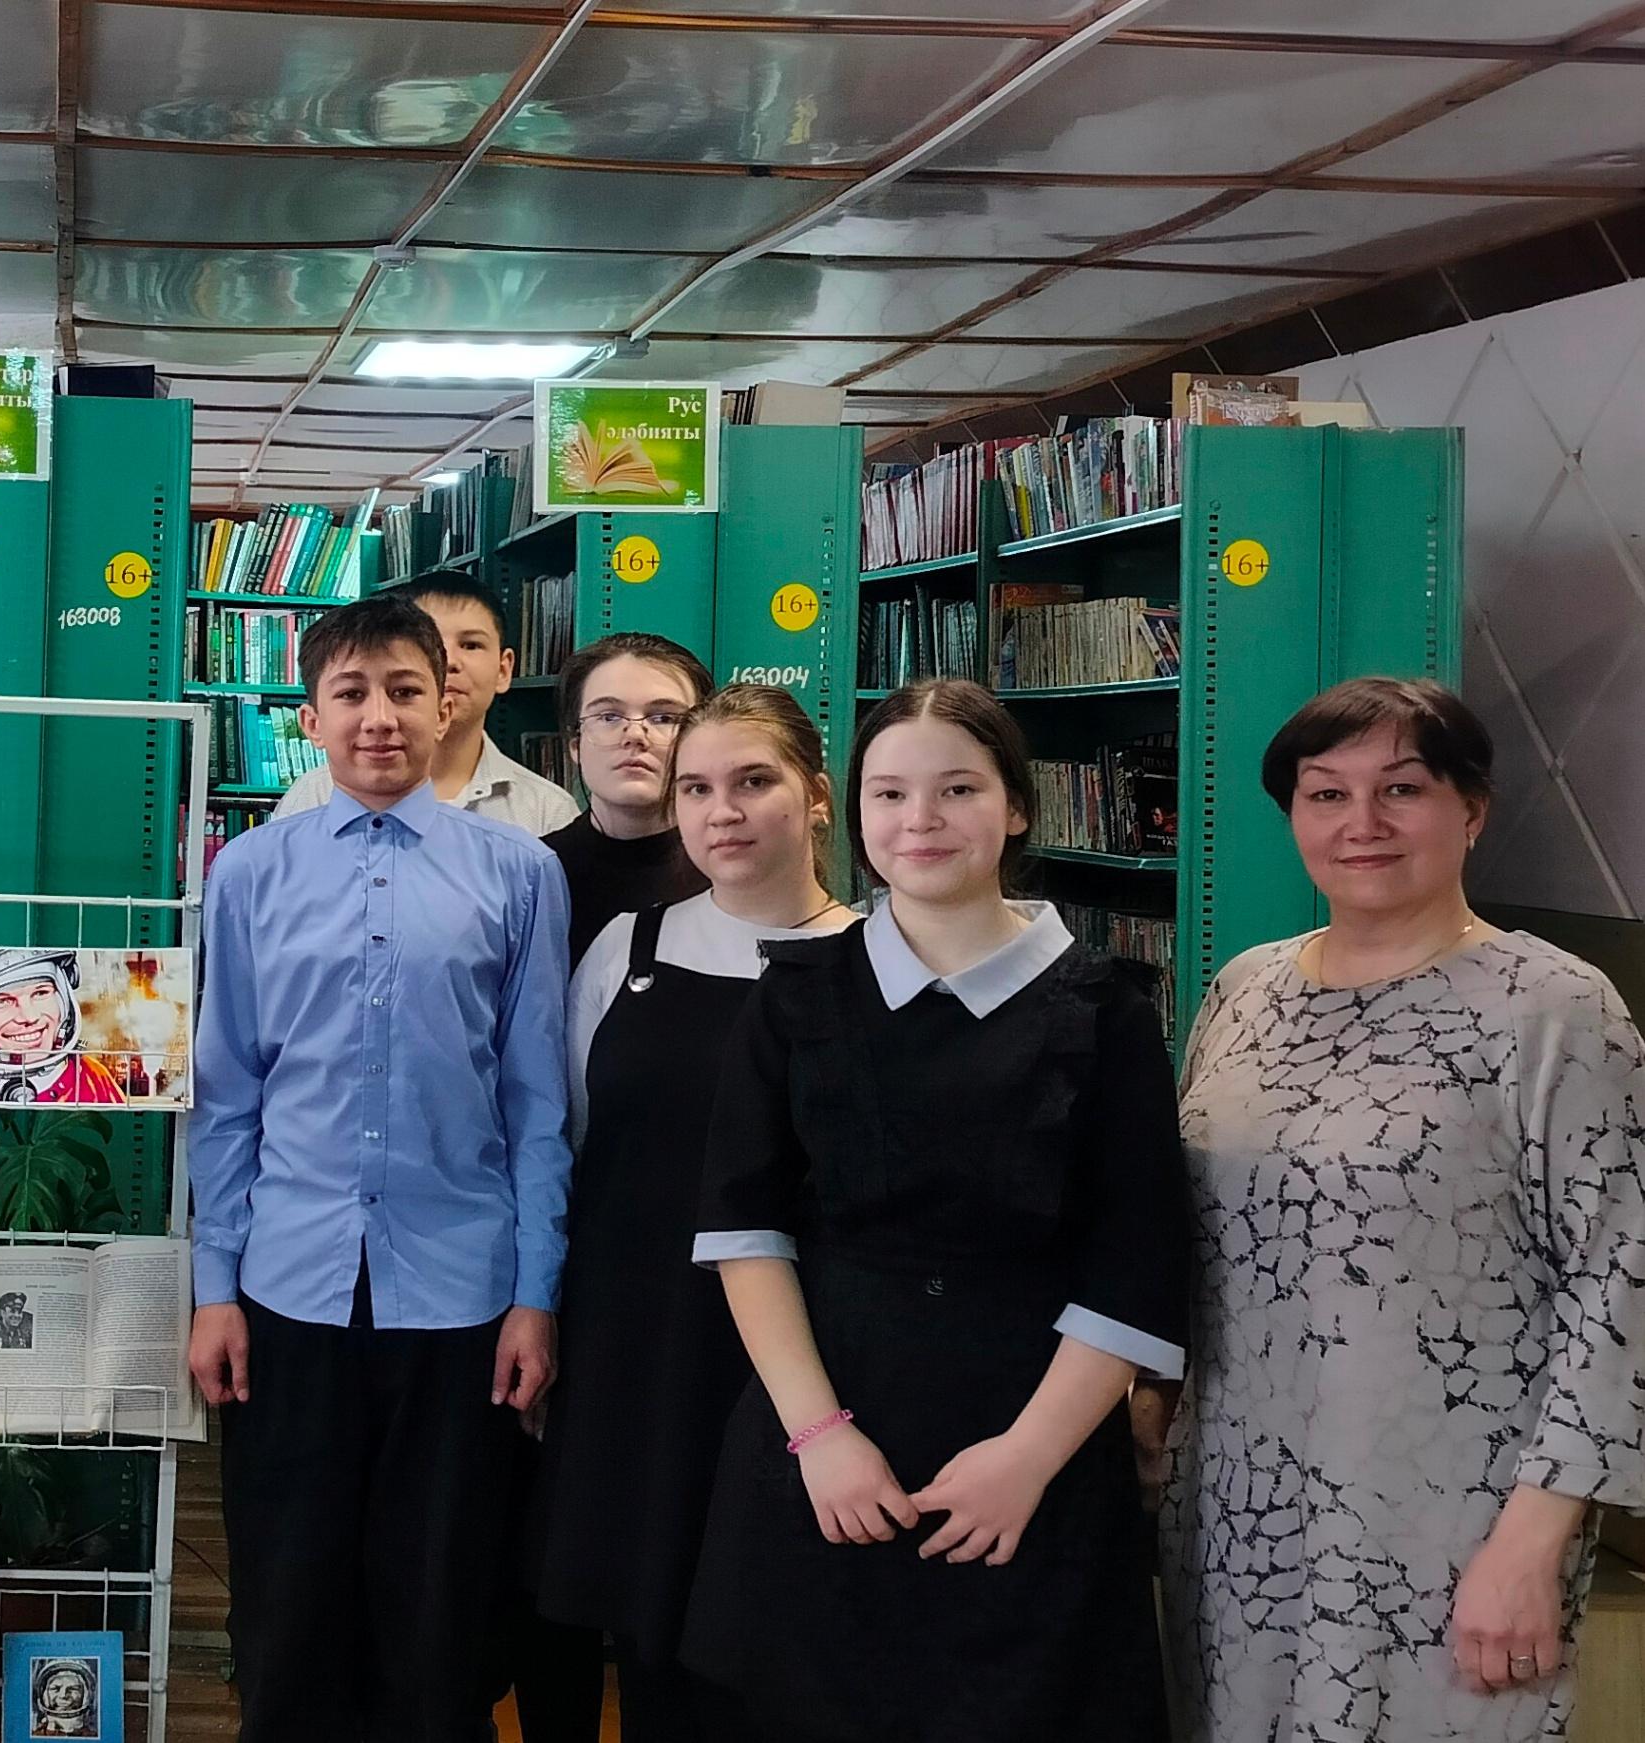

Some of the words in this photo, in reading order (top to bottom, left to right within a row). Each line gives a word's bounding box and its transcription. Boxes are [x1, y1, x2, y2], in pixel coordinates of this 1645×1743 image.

[667, 395, 703, 418] Рус
[605, 421, 701, 441] әдәбияты
[613, 550, 660, 572] 16+
[1223, 553, 1270, 577] 16+
[105, 563, 152, 586] 16+
[775, 593, 817, 614] 16+
[57, 606, 121, 630] 163008
[728, 665, 810, 689] 163004
